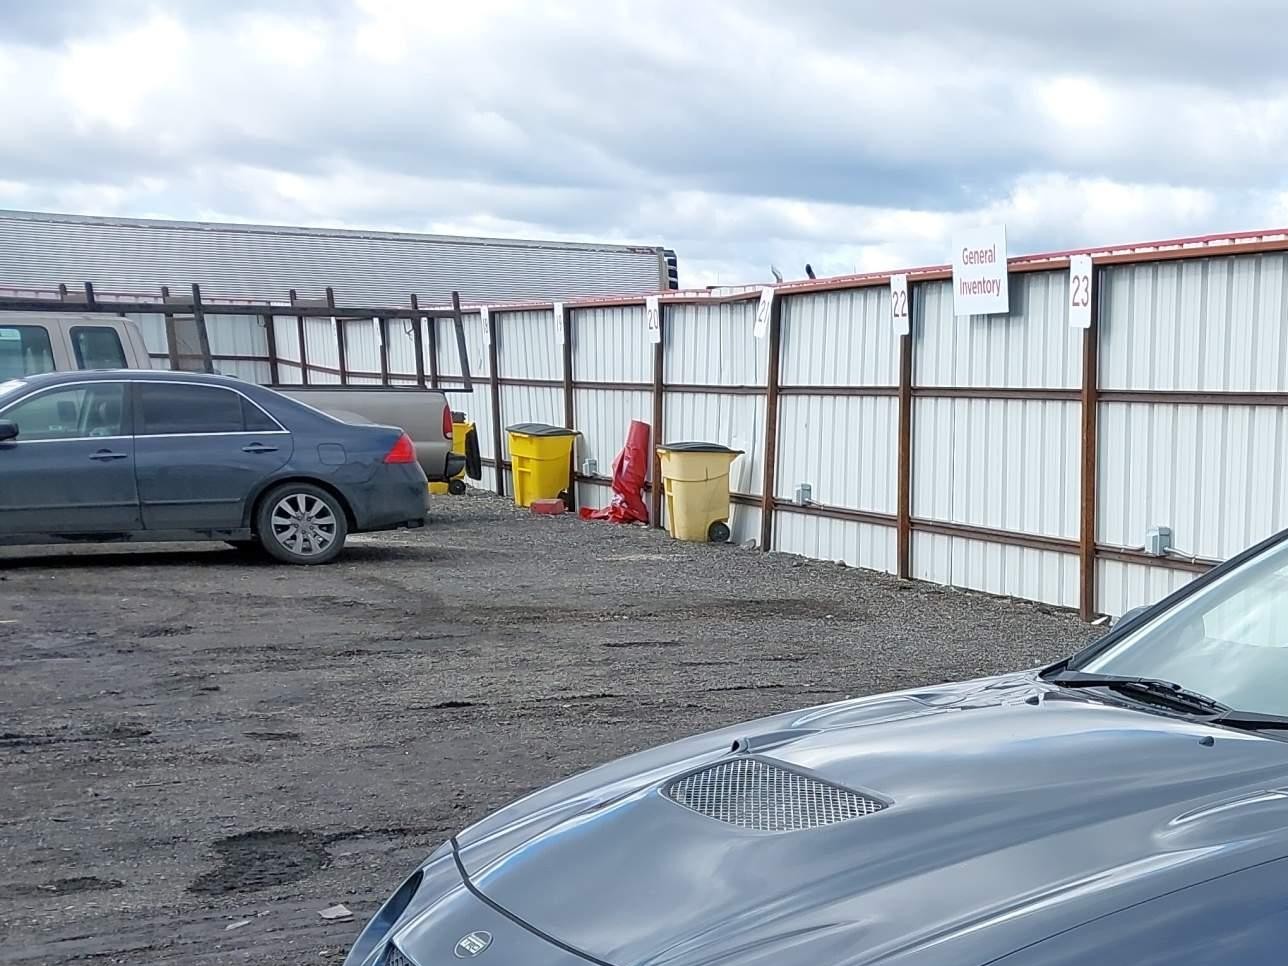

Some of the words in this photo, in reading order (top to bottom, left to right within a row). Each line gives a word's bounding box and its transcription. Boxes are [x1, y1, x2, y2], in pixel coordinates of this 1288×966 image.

[962, 243, 996, 265] General
[959, 276, 1001, 297] Inventory
[1072, 274, 1090, 308] 23
[892, 290, 908, 318] 22
[647, 308, 659, 330] 20
